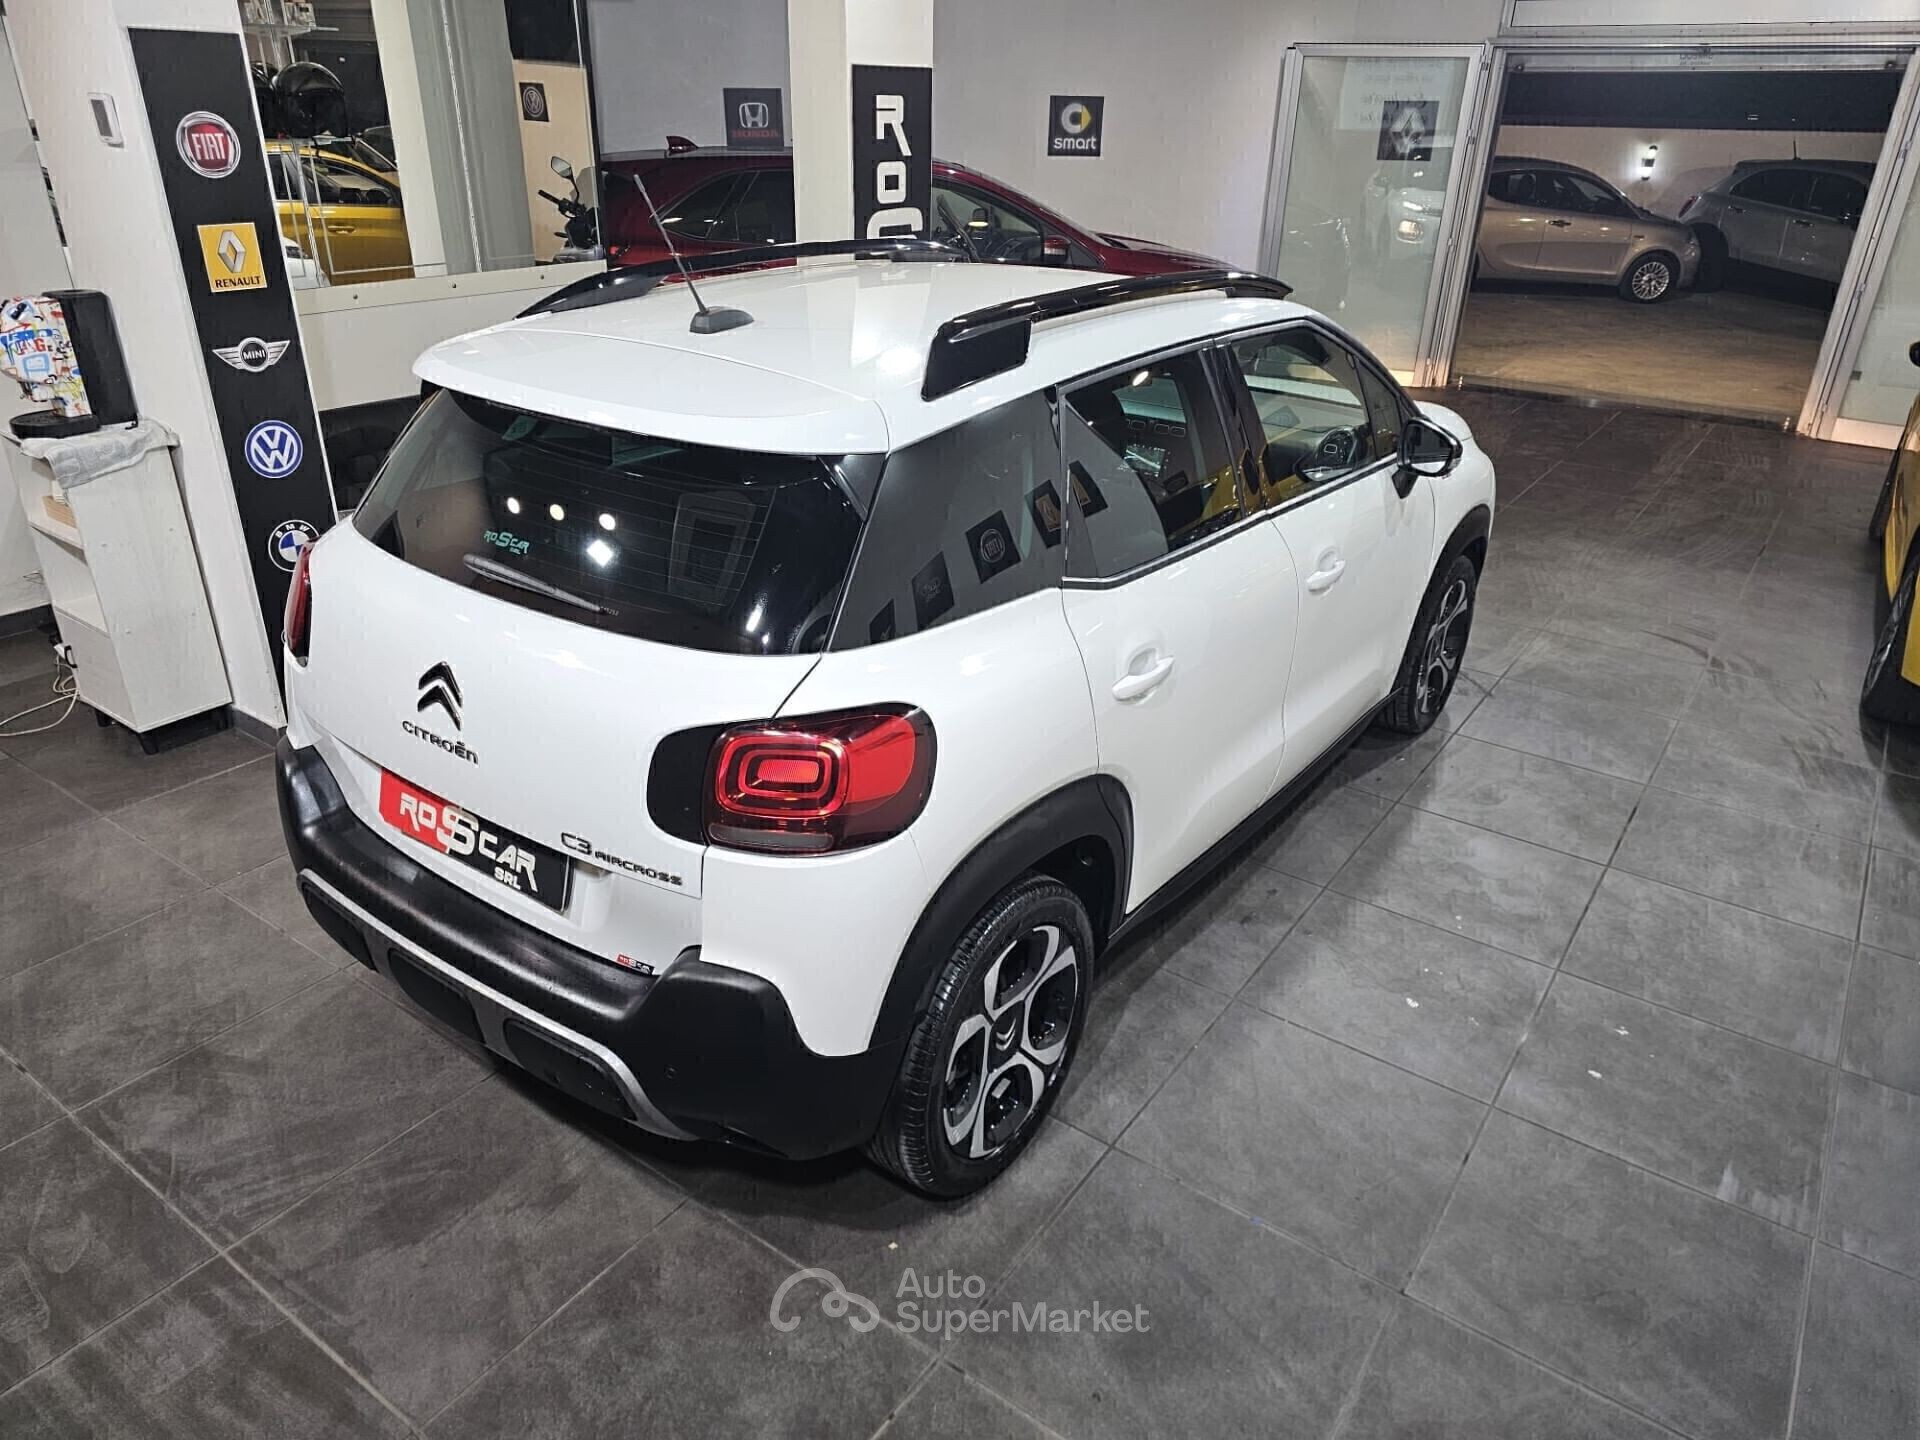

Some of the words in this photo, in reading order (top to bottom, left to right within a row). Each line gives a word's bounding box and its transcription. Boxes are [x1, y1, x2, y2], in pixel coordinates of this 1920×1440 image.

[191, 133, 226, 160] FIAT
[1054, 136, 1097, 150] smart
[215, 276, 261, 288] RENAULT
[243, 350, 266, 360] MINI
[275, 523, 310, 539] BMW
[561, 832, 593, 856] C3
[595, 851, 683, 886] AIRCROSS
[494, 867, 522, 890] SRL
